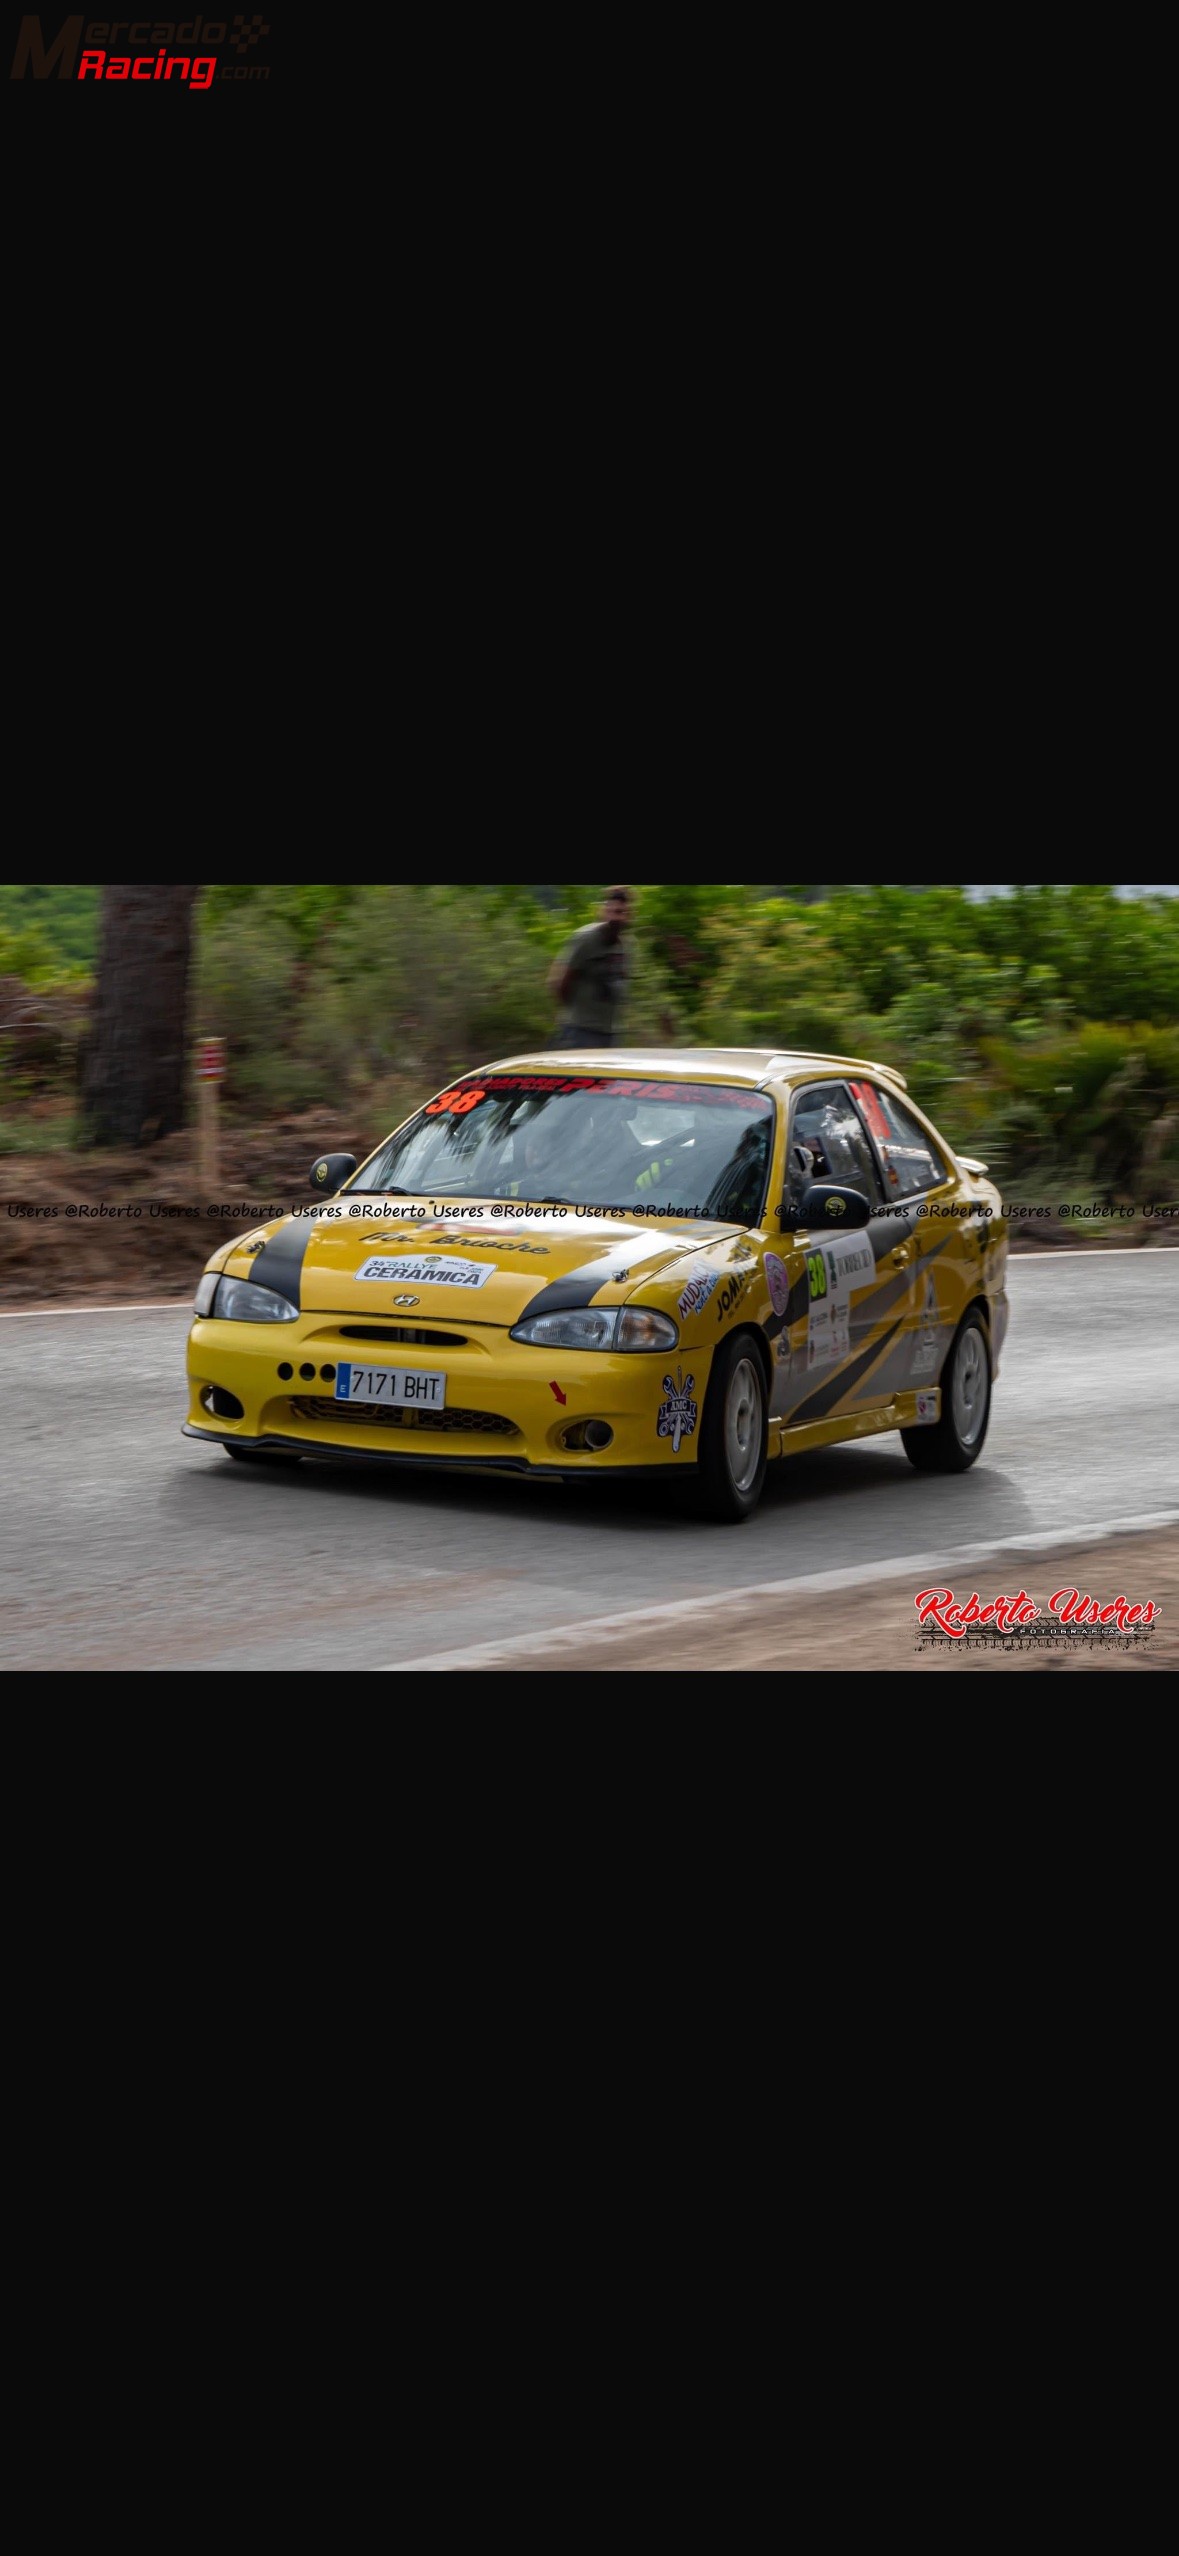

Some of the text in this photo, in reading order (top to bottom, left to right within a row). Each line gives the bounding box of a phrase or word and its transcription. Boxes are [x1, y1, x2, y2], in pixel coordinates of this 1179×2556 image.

[560, 1078, 678, 1098] PERIS
[425, 1090, 486, 1114] 38
[359, 1231, 551, 1254] Mr. Brioche
[363, 1266, 481, 1285] CERAMICA
[388, 1261, 438, 1269] RALLYE
[808, 1254, 827, 1297] 38
[340, 1371, 440, 1400] E 7171 BHT
[670, 1401, 688, 1411] AMC
